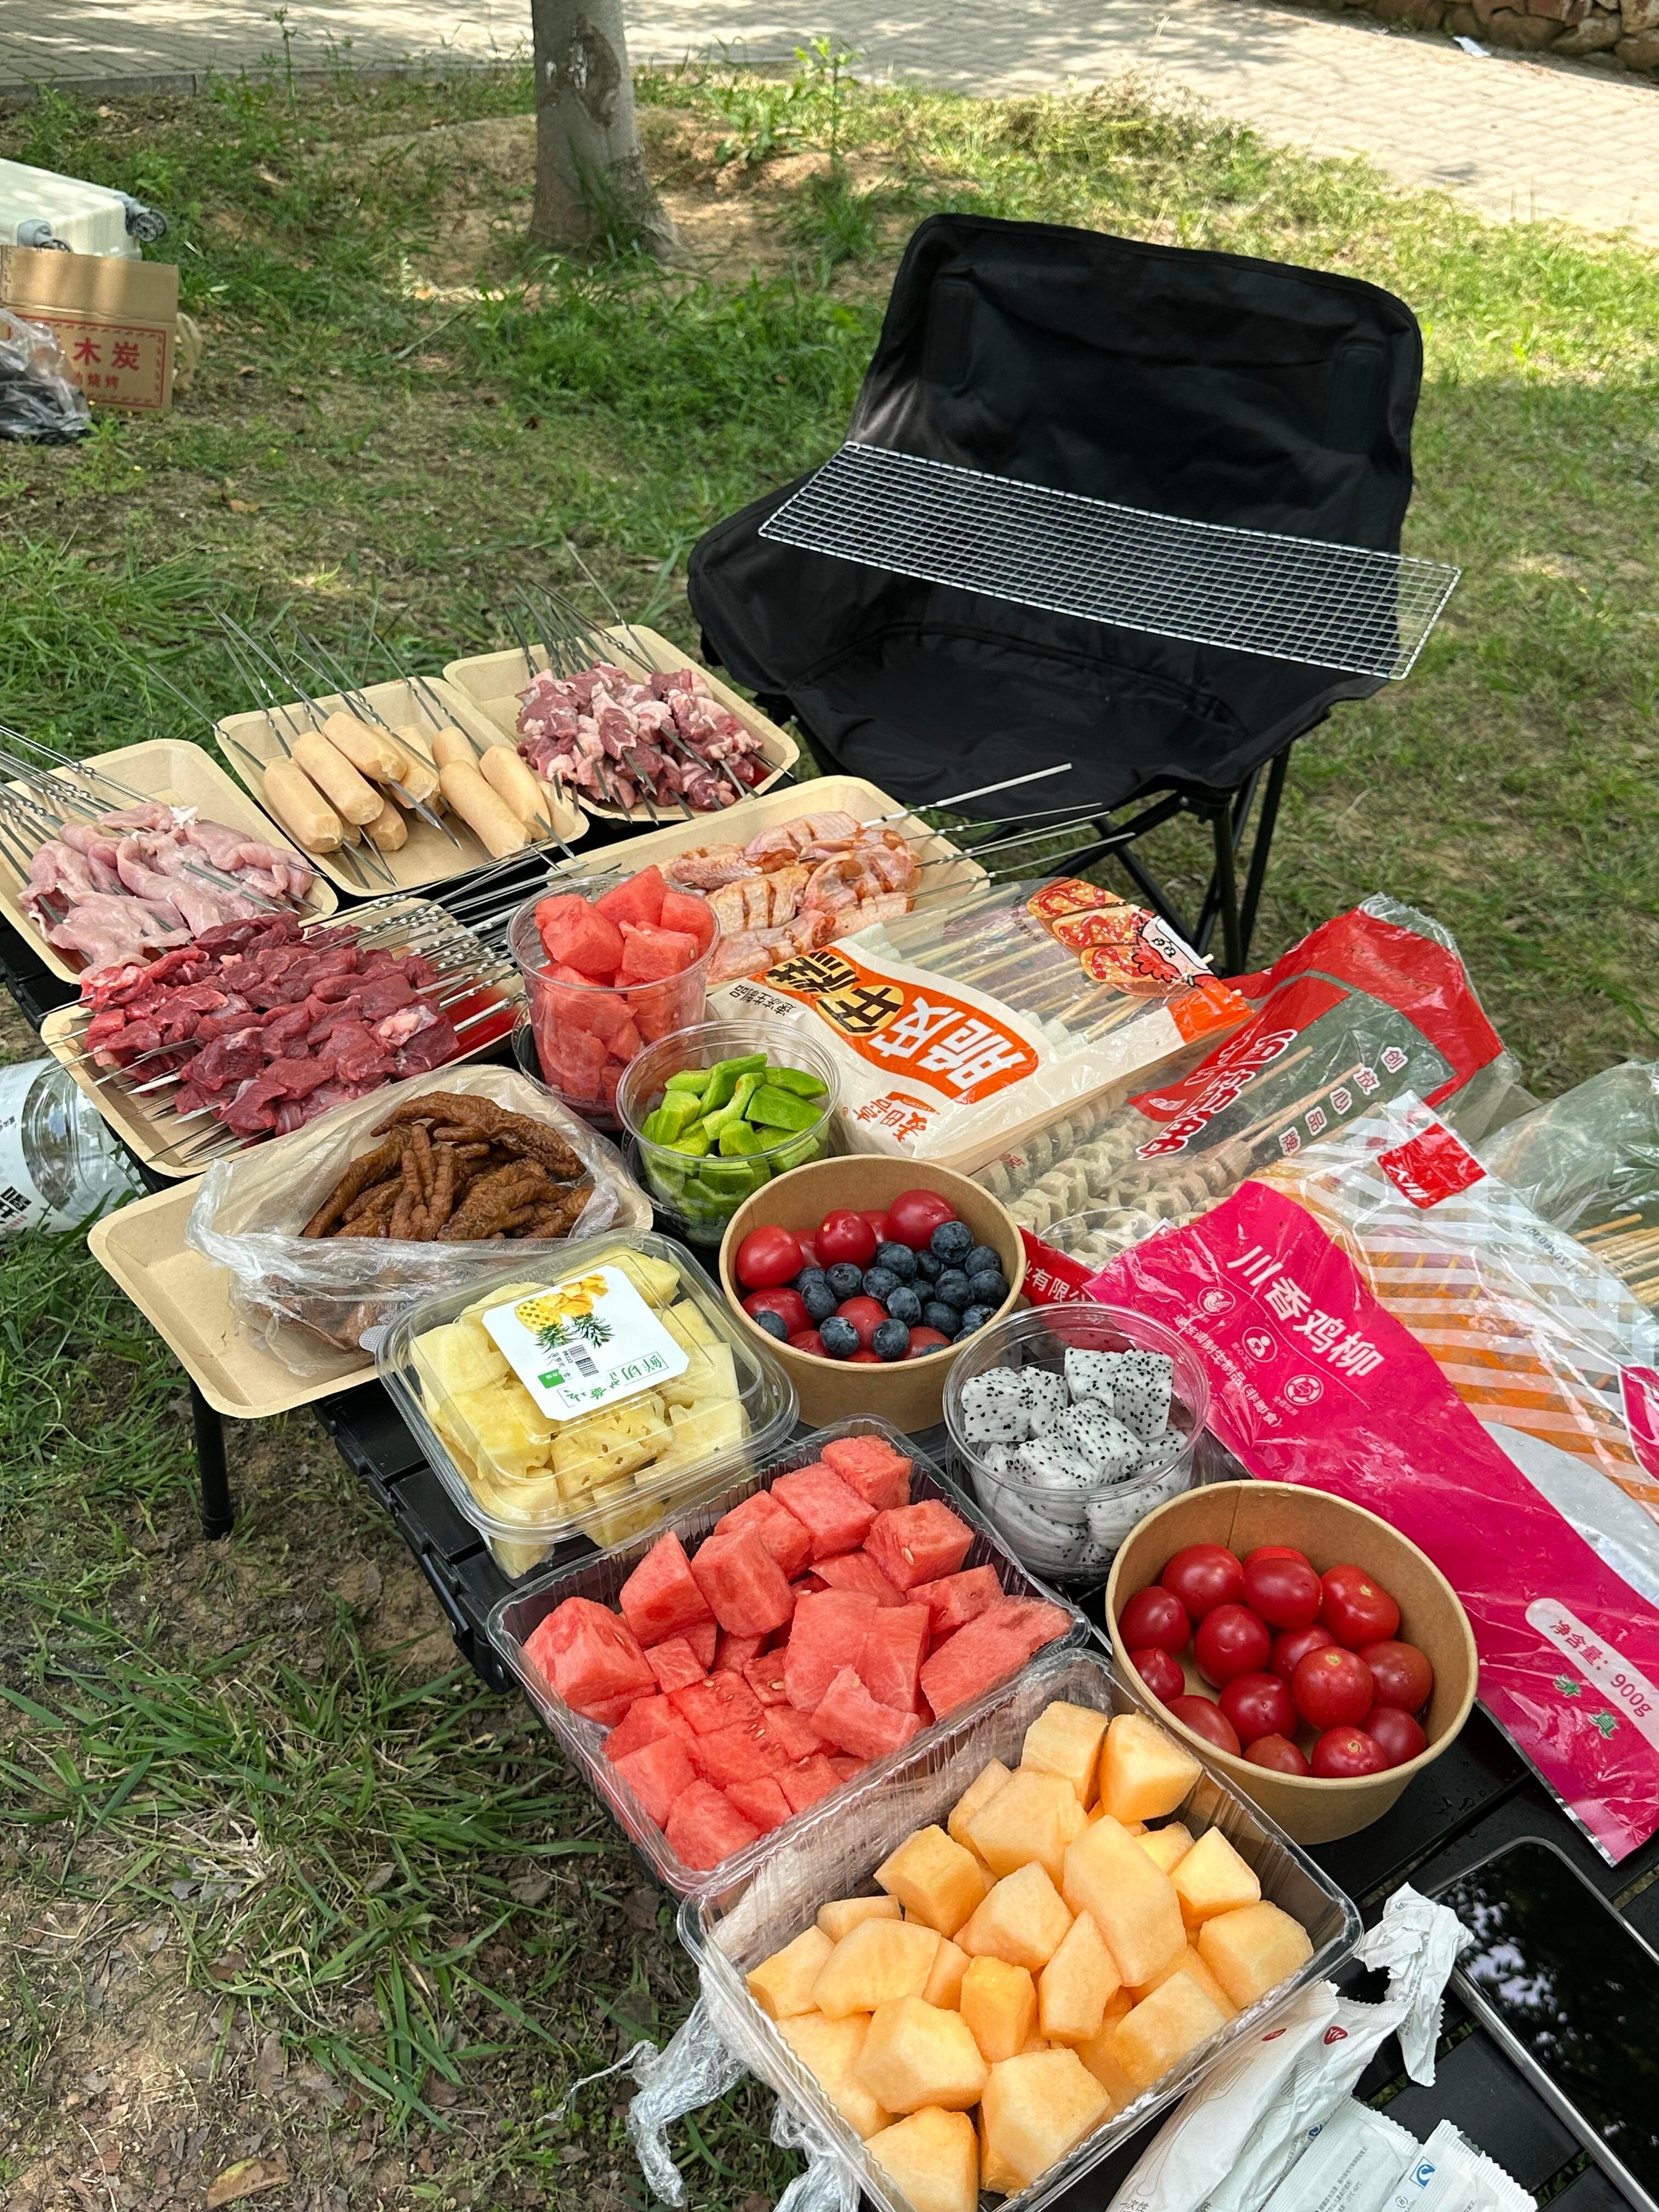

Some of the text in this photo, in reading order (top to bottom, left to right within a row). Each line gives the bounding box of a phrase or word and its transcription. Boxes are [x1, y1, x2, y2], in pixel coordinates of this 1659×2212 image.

[728, 984, 797, 1017] 速冻生制品
[764, 950, 1027, 1091] 脆皮年糕
[1228, 1245, 1385, 1379] 川香鸡柳
